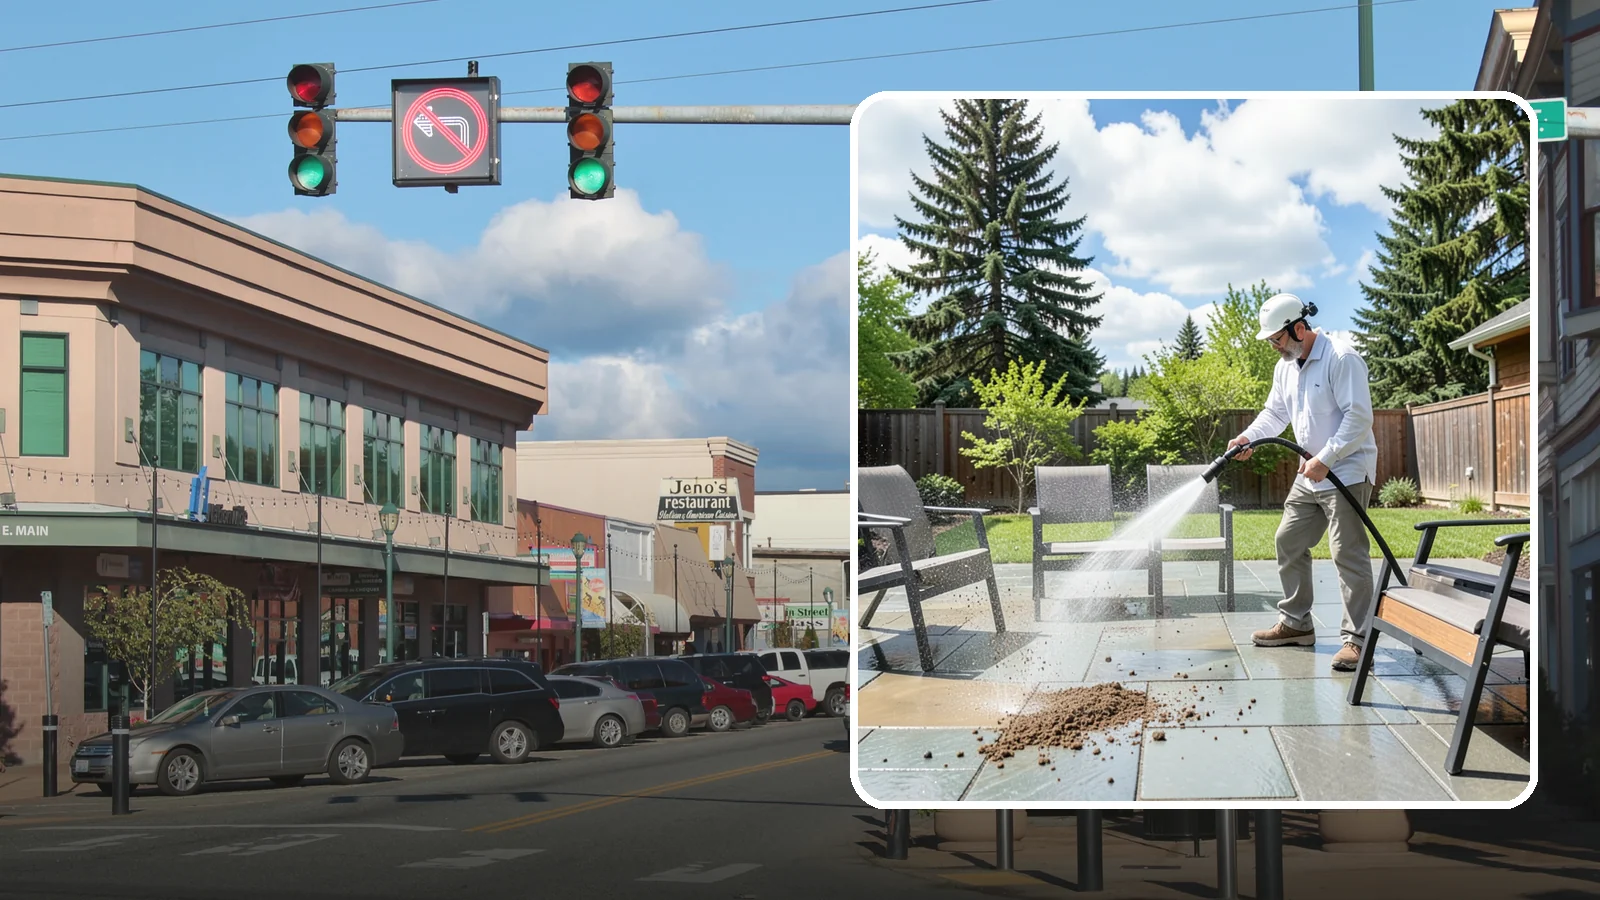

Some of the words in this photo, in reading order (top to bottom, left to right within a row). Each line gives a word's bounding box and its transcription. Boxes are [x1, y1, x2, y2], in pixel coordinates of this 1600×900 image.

[670, 480, 727, 494] Jeno's
[665, 496, 731, 509] restaurant
[659, 510, 682, 520] Italian
[686, 510, 714, 519] American
[715, 509, 738, 519] Cuisine
[2, 525, 12, 536] E.
[16, 525, 48, 536] MAIN
[797, 608, 828, 616] Street
